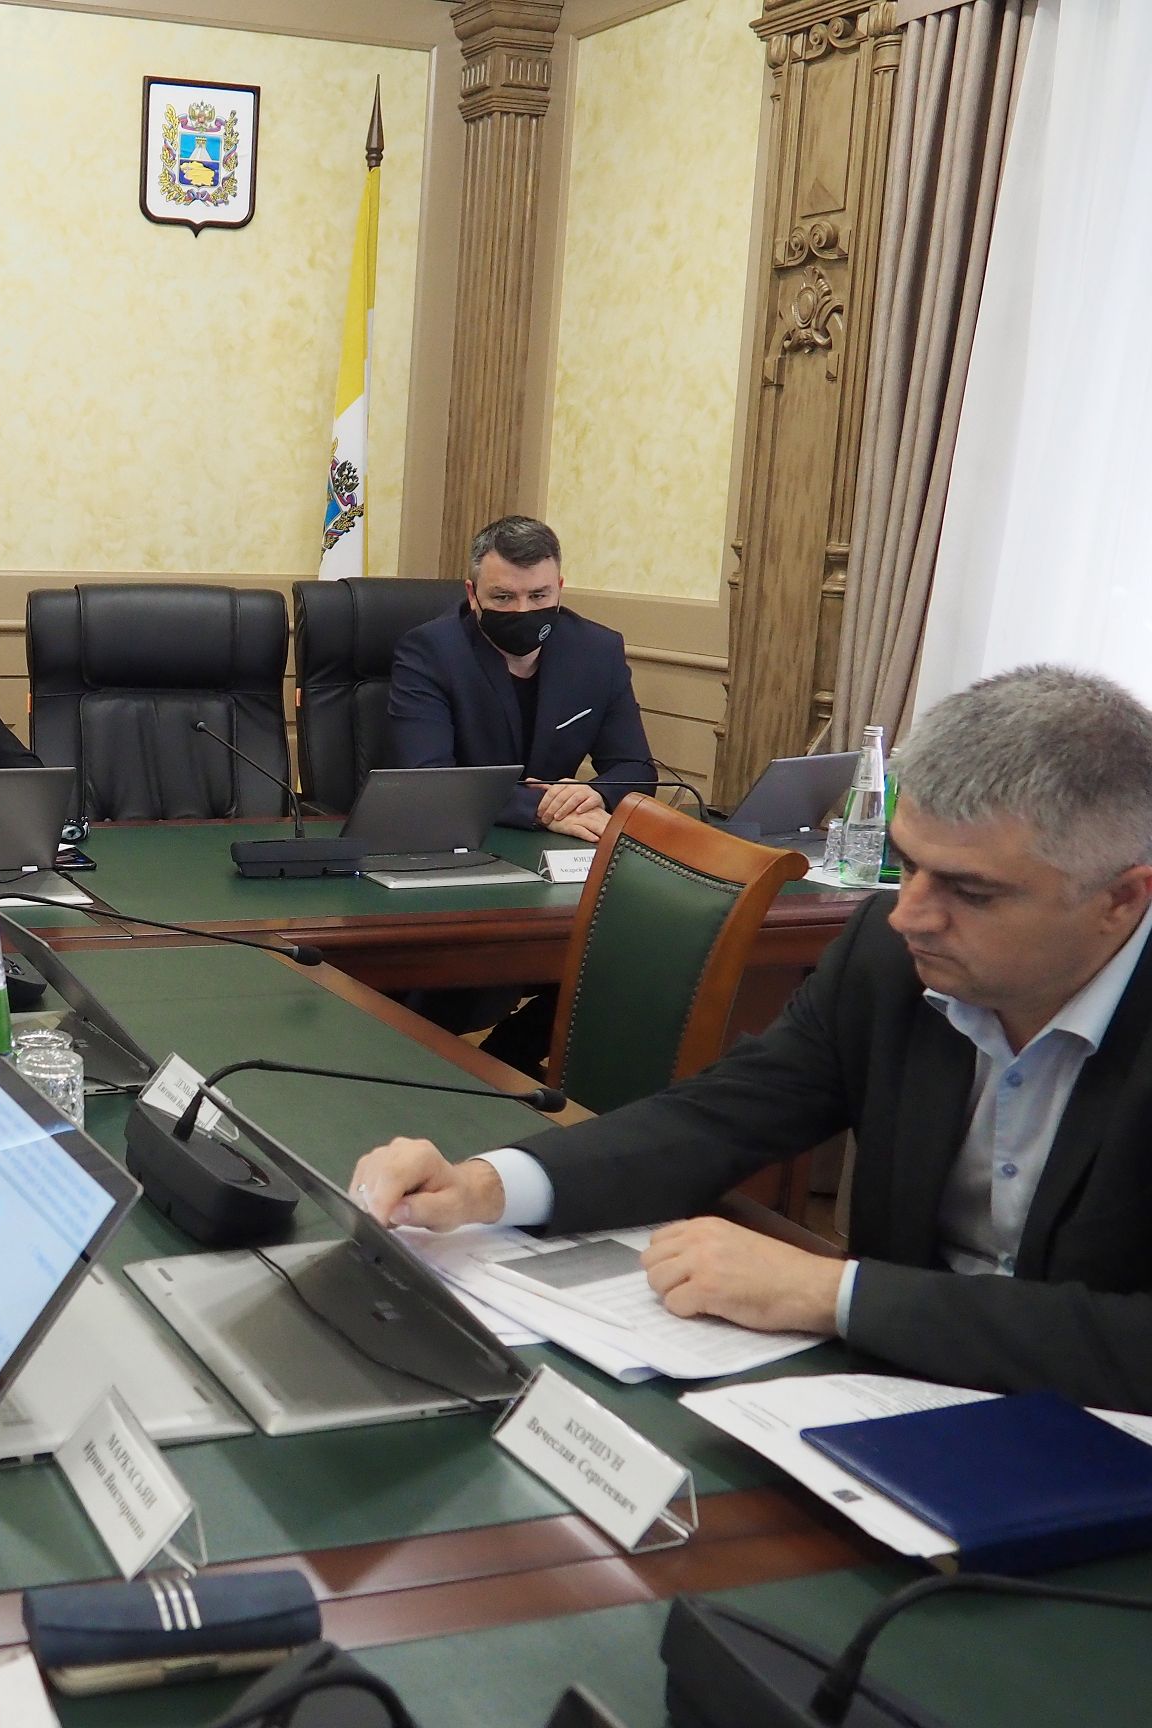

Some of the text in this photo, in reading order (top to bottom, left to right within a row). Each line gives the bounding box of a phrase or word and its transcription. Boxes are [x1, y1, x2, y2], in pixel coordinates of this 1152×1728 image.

[106, 1433, 158, 1510] МАРКАСЬЯН
[526, 1416, 638, 1515] Вячеслав Сергеевич
[564, 1417, 626, 1472] КОРШУН
[82, 1440, 146, 1541] Ирина Викторовна
